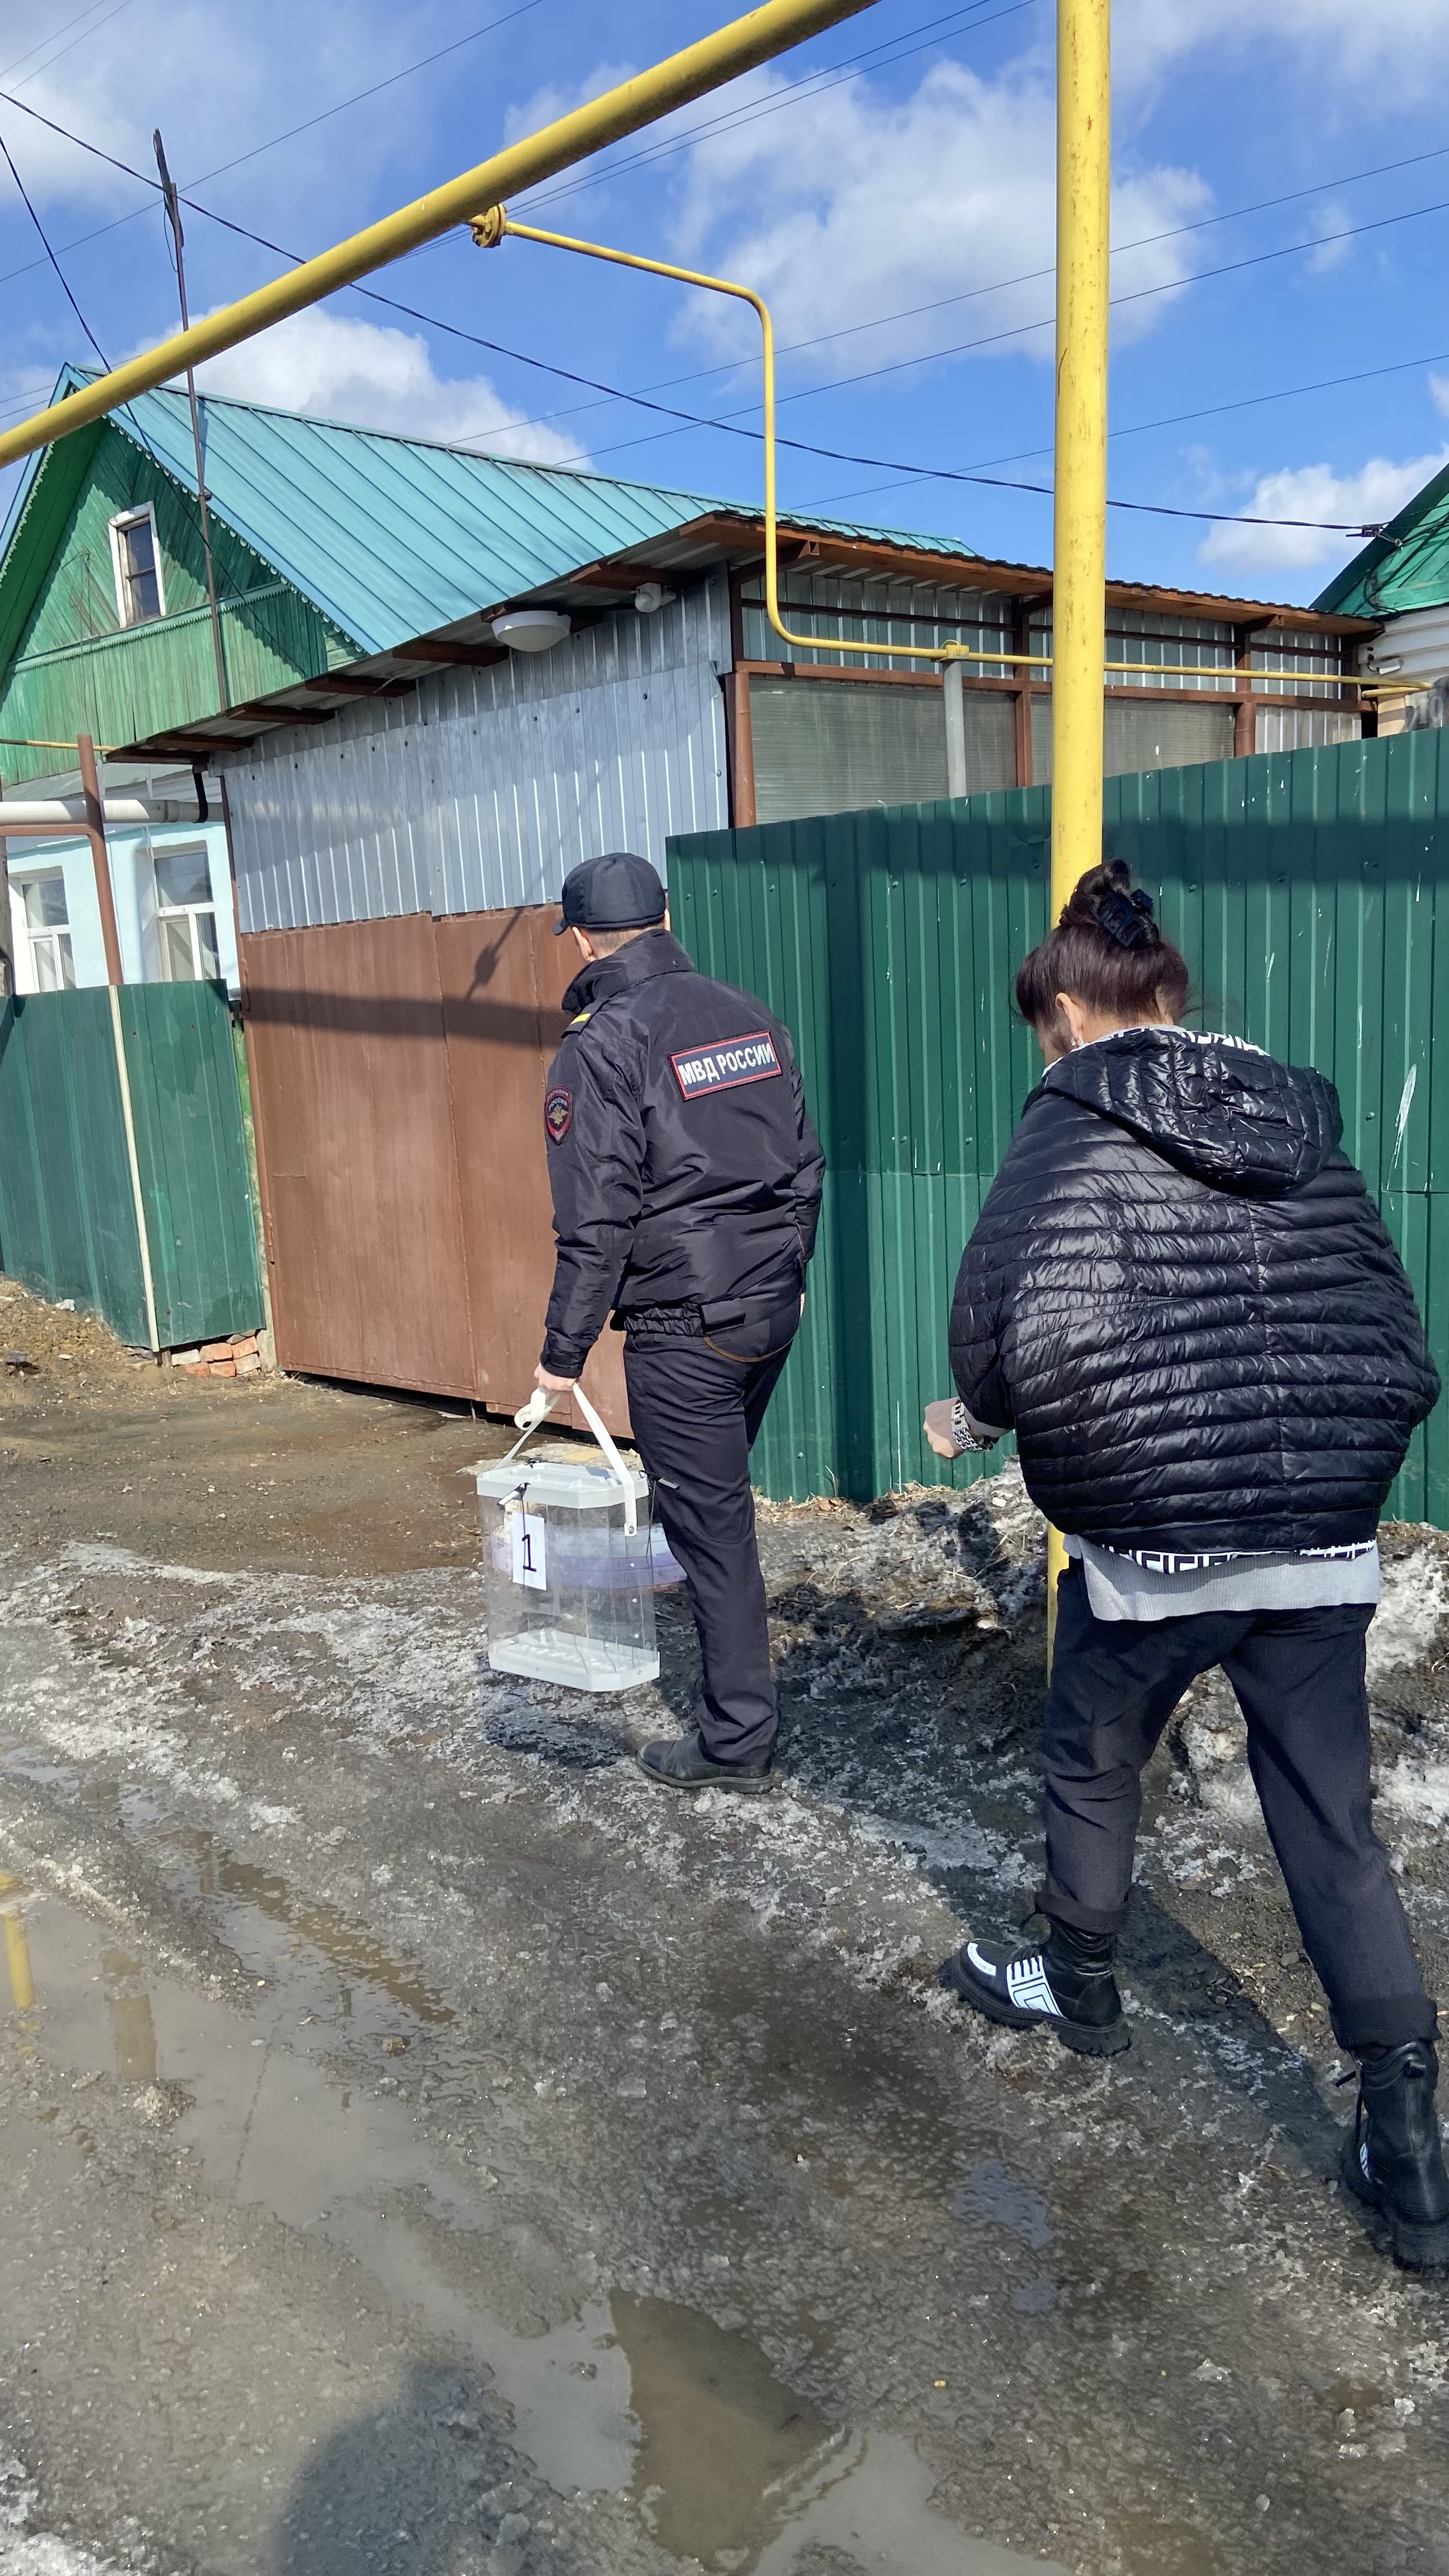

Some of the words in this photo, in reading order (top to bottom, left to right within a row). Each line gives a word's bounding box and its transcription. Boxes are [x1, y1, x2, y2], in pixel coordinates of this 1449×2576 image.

[678, 1057, 721, 1085] МВД
[716, 1042, 775, 1075] РОССИИ
[521, 1534, 537, 1572] 1
